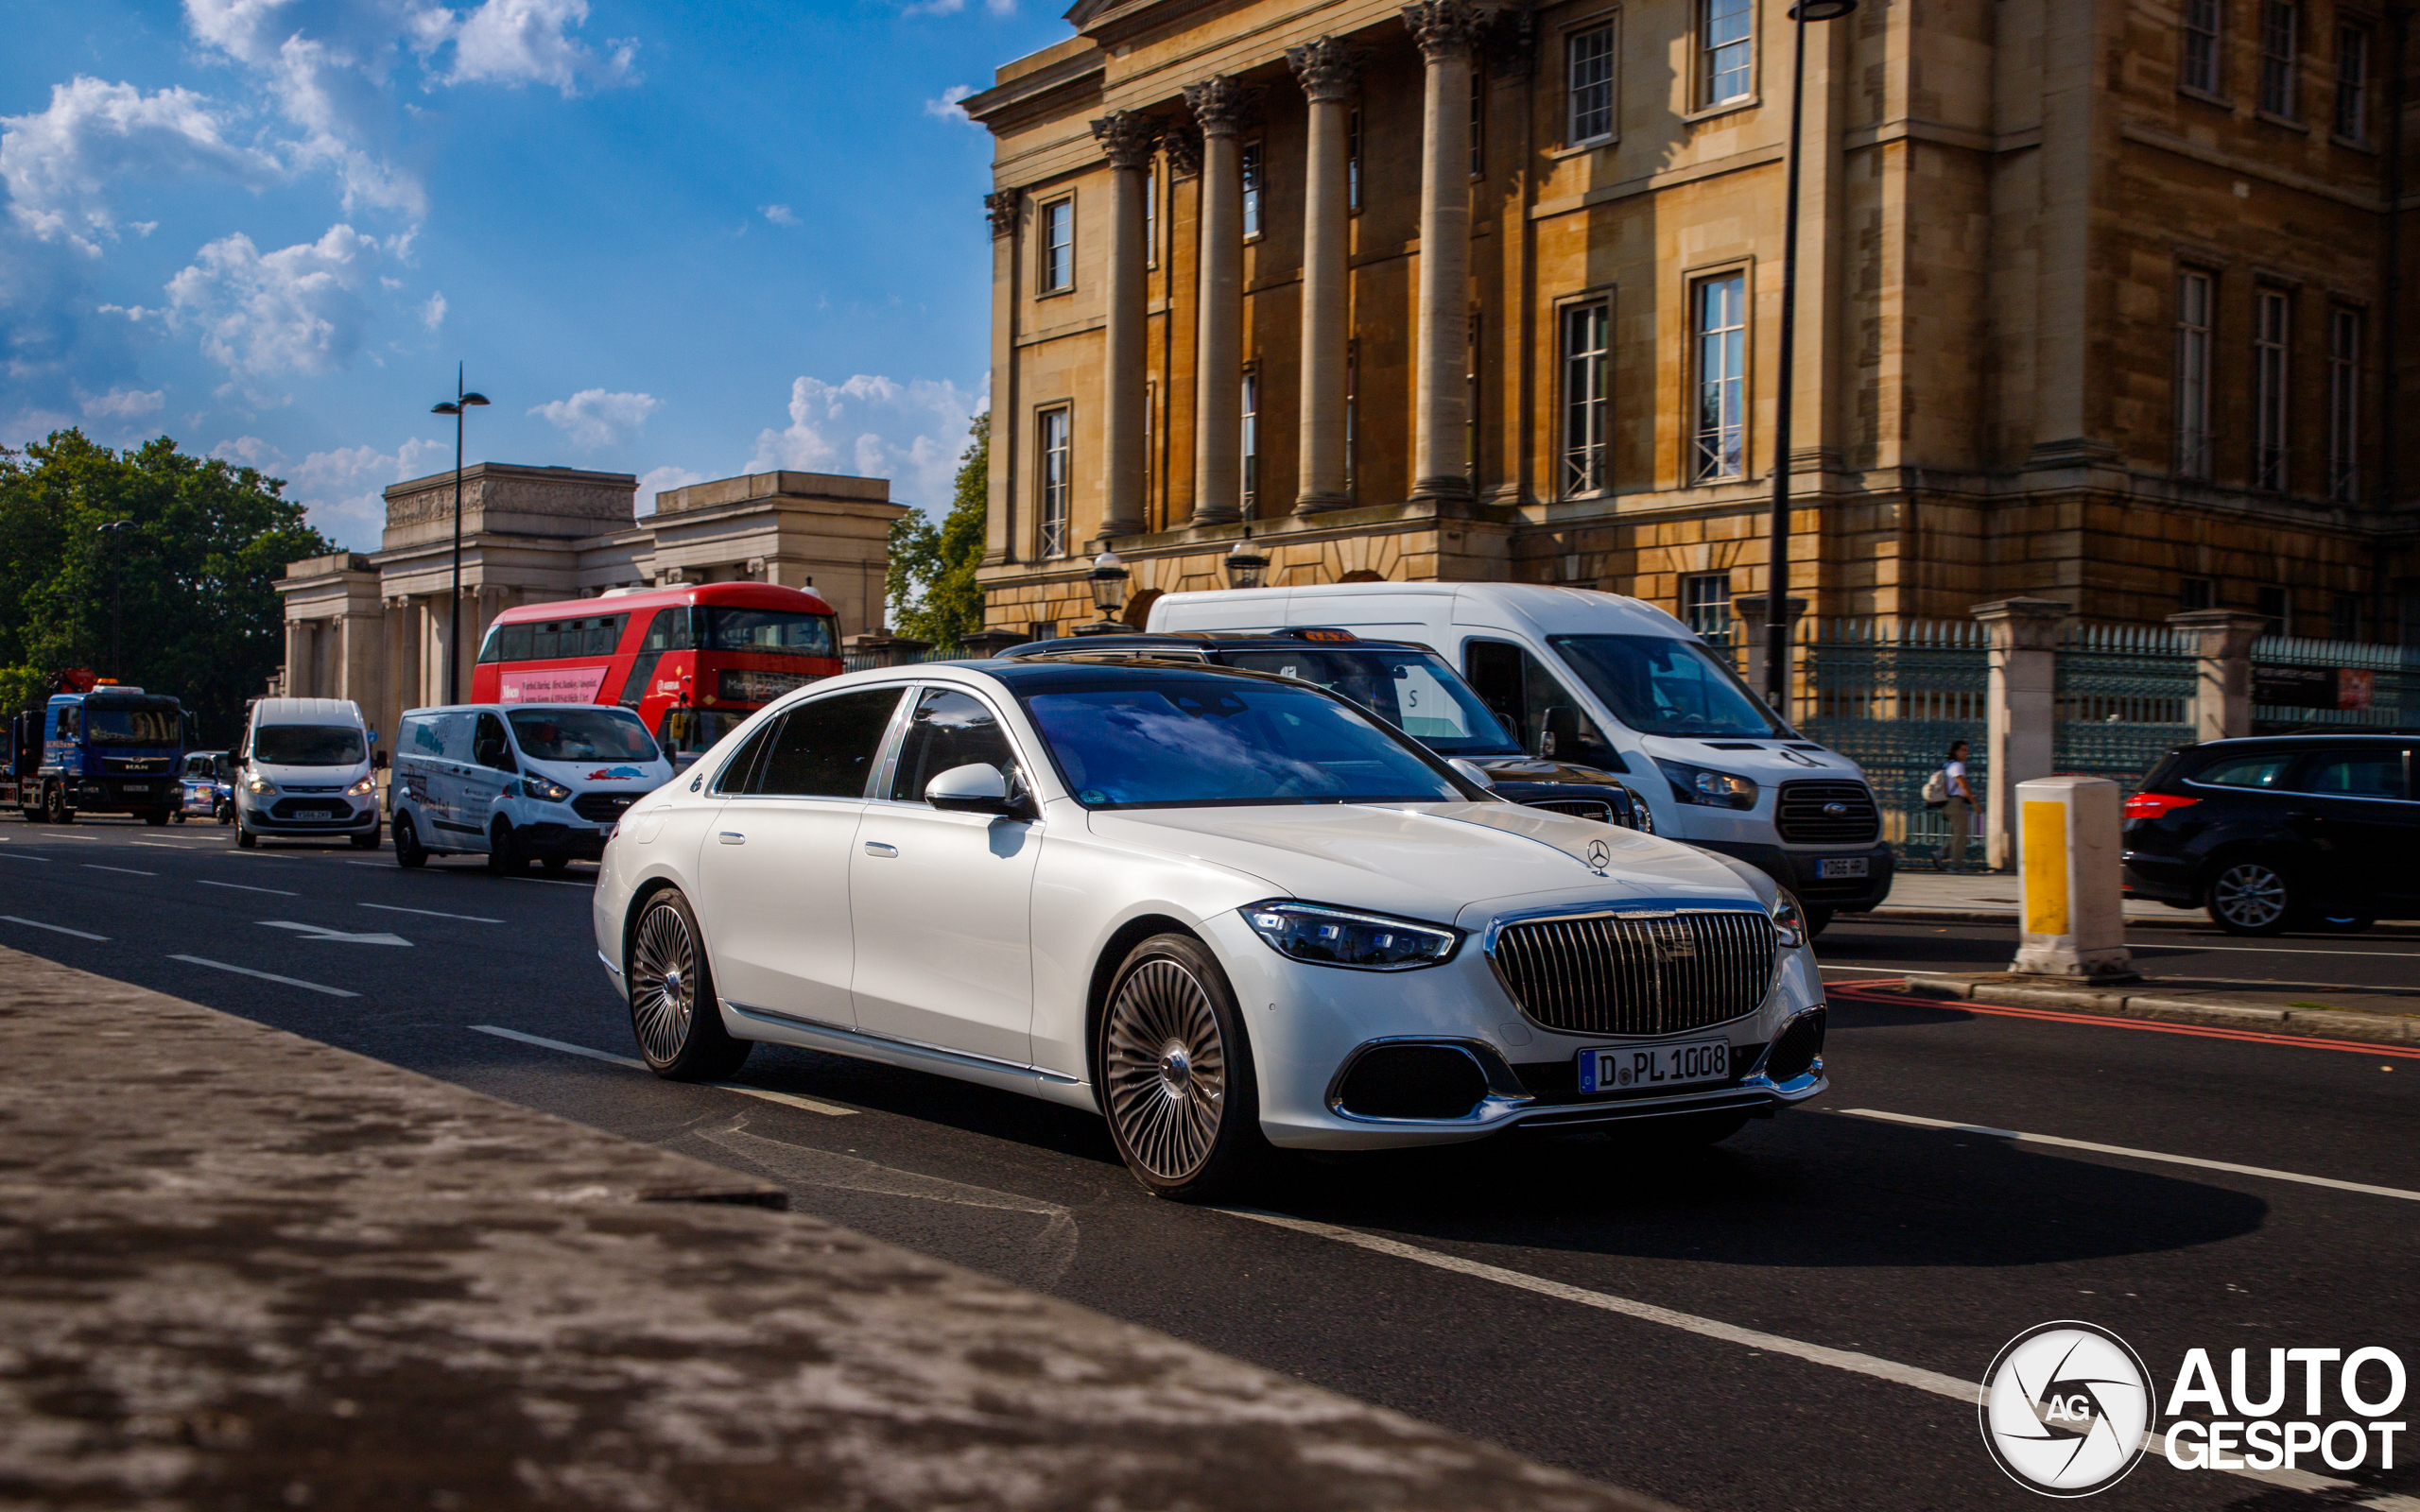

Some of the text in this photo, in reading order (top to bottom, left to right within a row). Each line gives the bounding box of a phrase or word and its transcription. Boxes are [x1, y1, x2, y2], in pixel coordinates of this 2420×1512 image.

[1308, 631, 1355, 641] TAXI
[1599, 1044, 1725, 1086] D PL 1008
